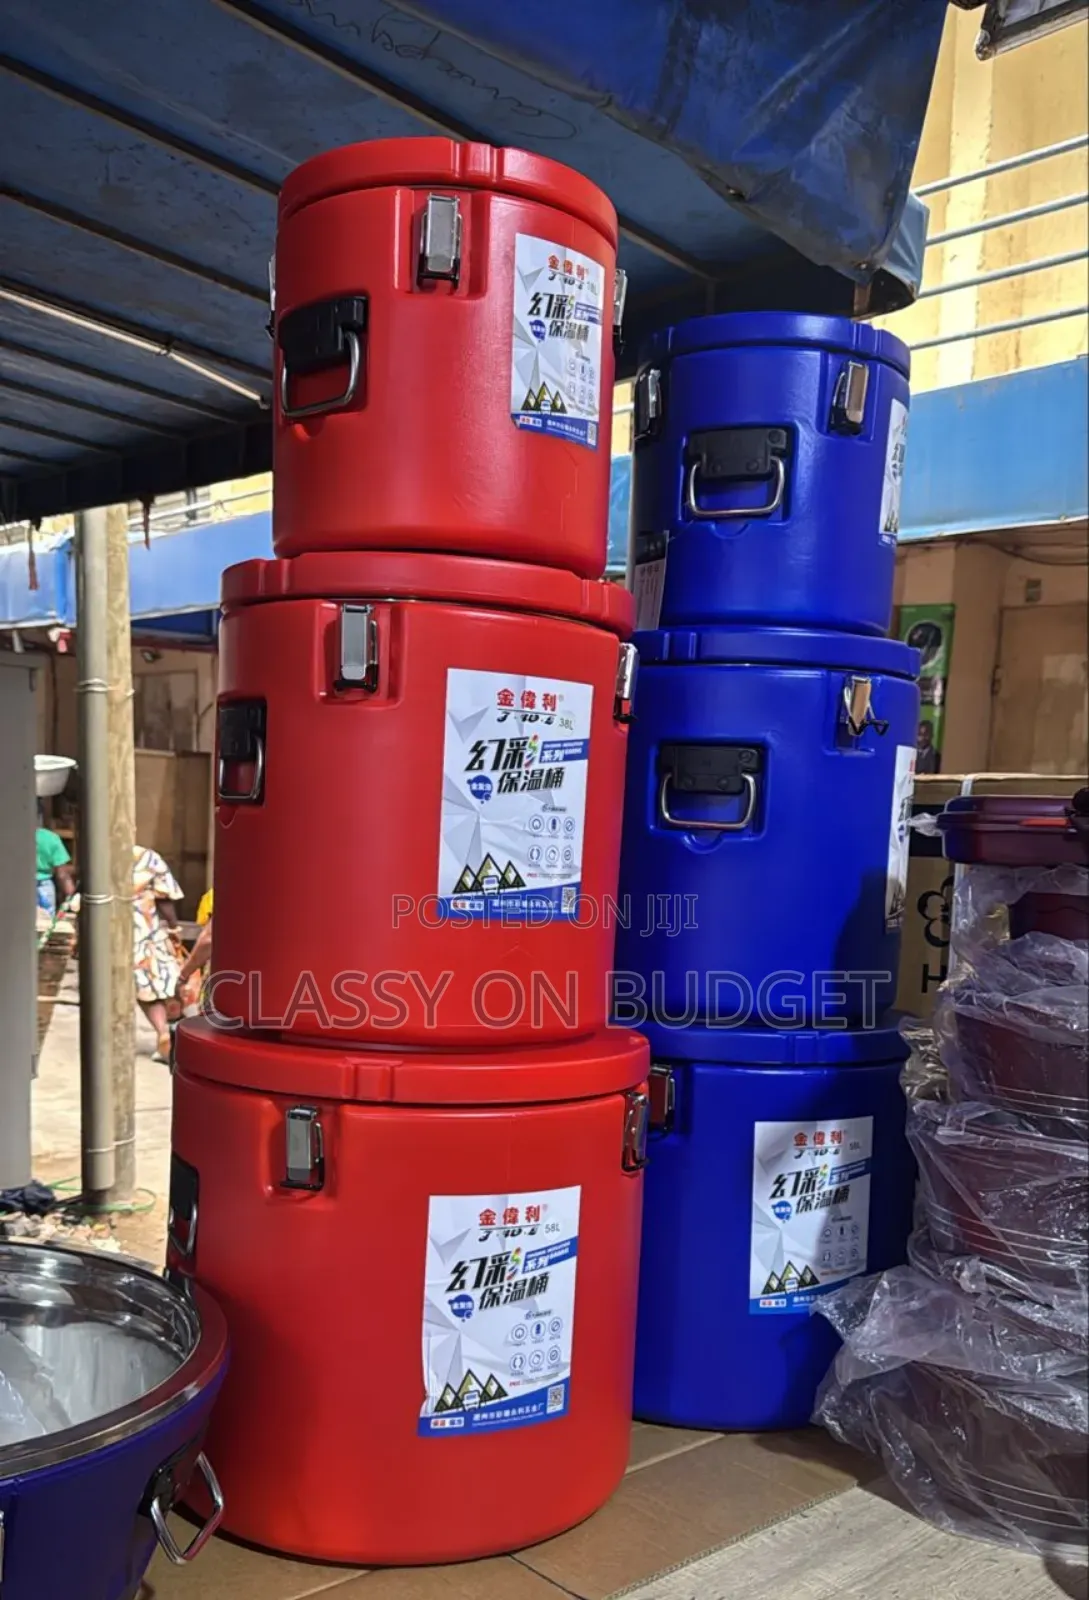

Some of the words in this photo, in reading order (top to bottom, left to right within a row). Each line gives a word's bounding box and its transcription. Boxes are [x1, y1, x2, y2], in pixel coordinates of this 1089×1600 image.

[464, 734, 539, 771] 幻彩
[497, 767, 565, 794] 保温桶
[545, 1222, 561, 1233] 58L
[445, 1247, 522, 1293] 幻彩
[479, 1271, 550, 1311] 保温桶
